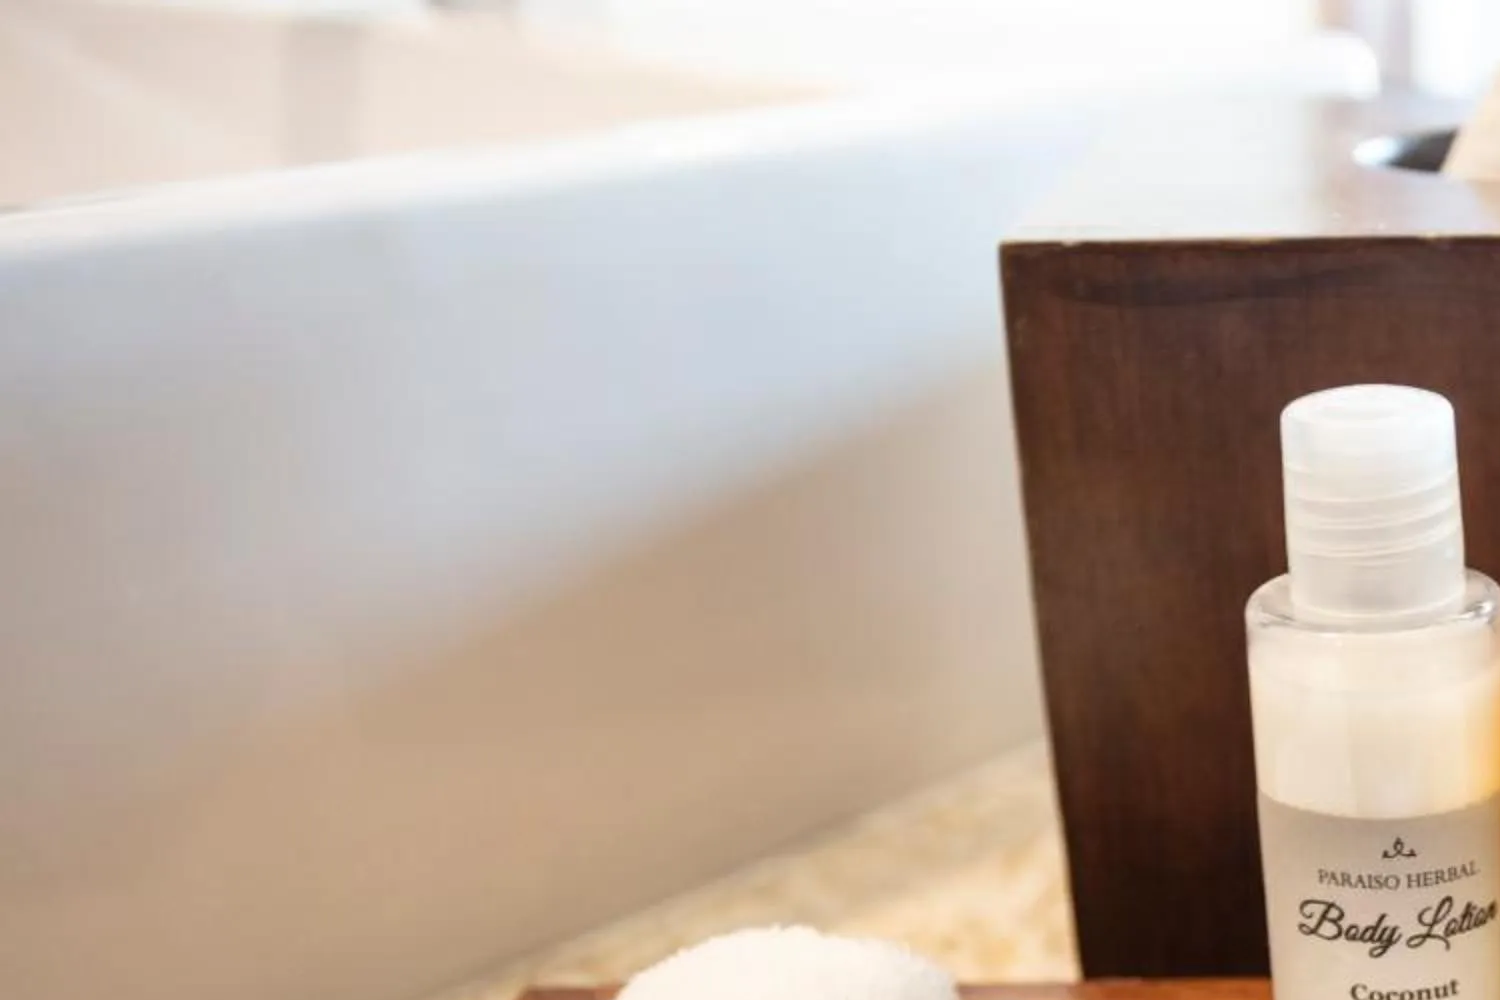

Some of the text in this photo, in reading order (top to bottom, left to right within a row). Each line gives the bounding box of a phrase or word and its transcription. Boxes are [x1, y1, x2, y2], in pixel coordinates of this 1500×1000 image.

[1317, 861, 1480, 891] PARAISO HERBAL
[1298, 895, 1498, 959] Body Lotion
